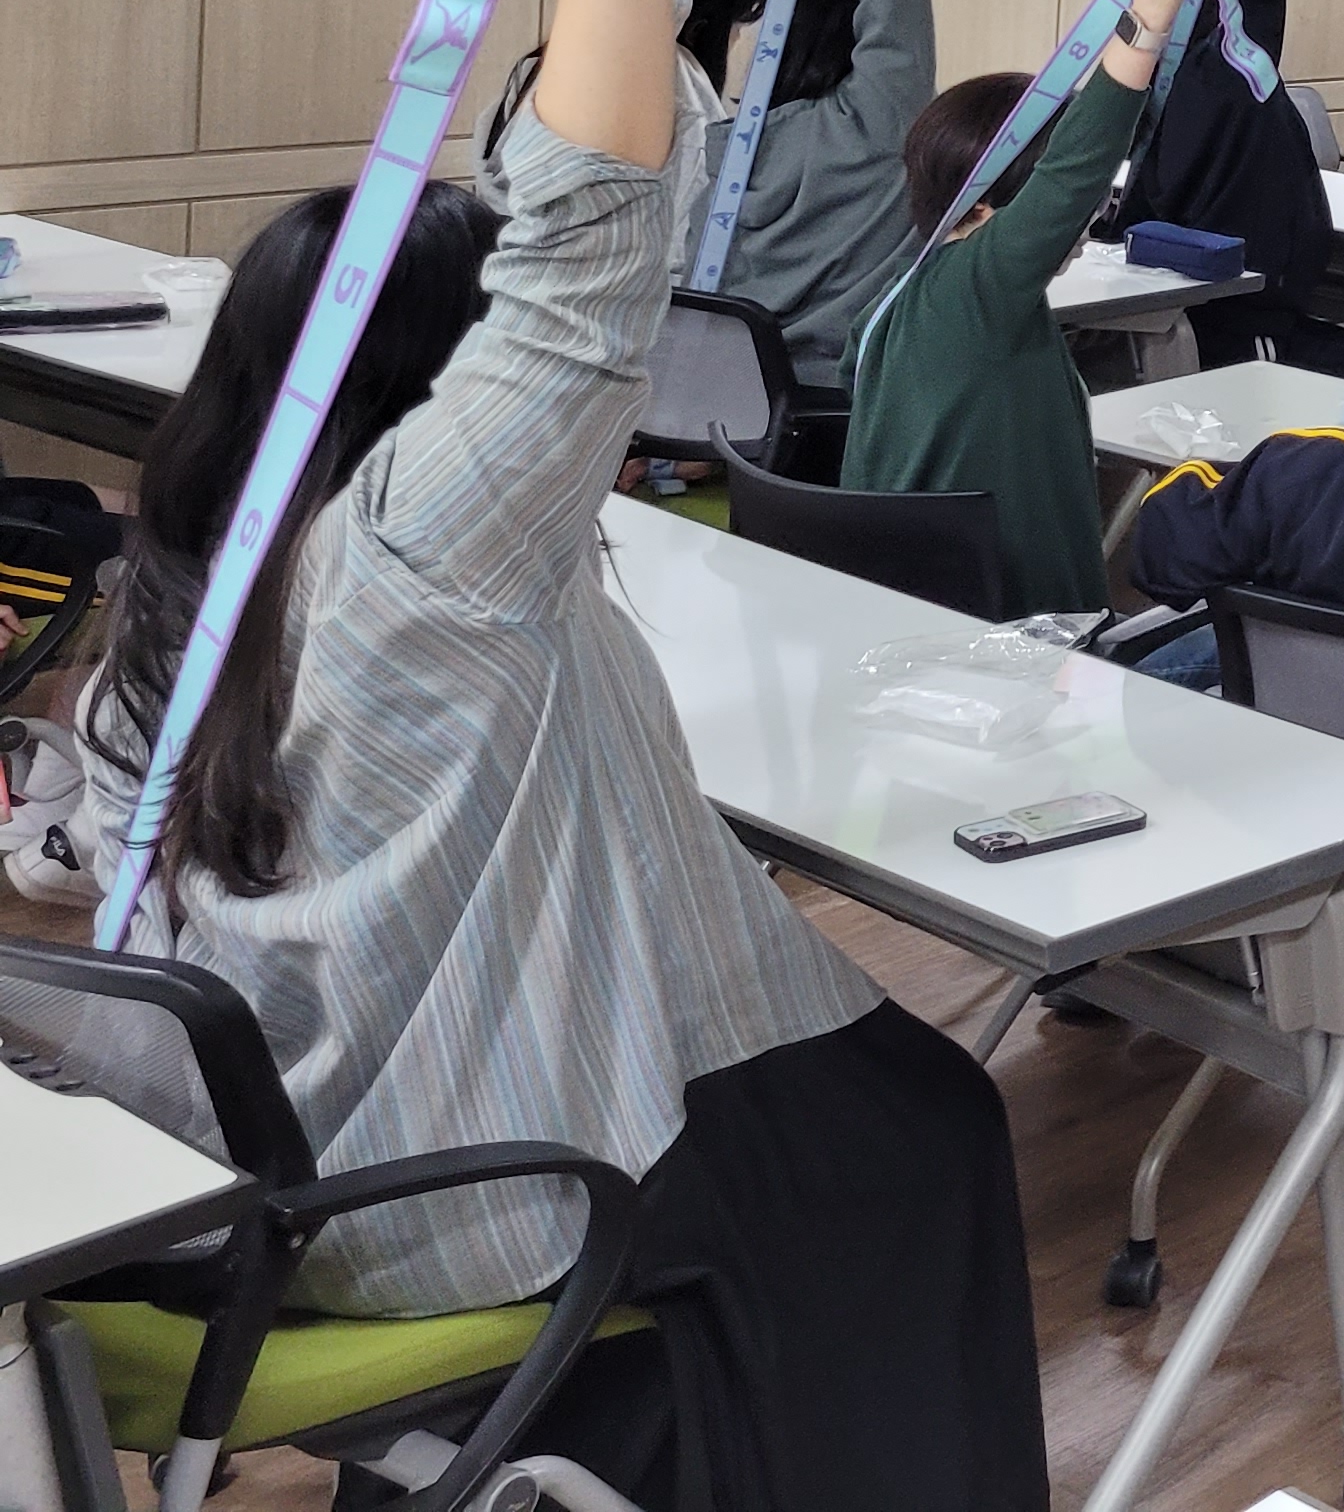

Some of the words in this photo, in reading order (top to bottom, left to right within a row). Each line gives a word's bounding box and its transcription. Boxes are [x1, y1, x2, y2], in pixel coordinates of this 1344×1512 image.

[1068, 40, 1090, 61] 8
[333, 262, 370, 307] 5
[237, 507, 265, 554] 6
